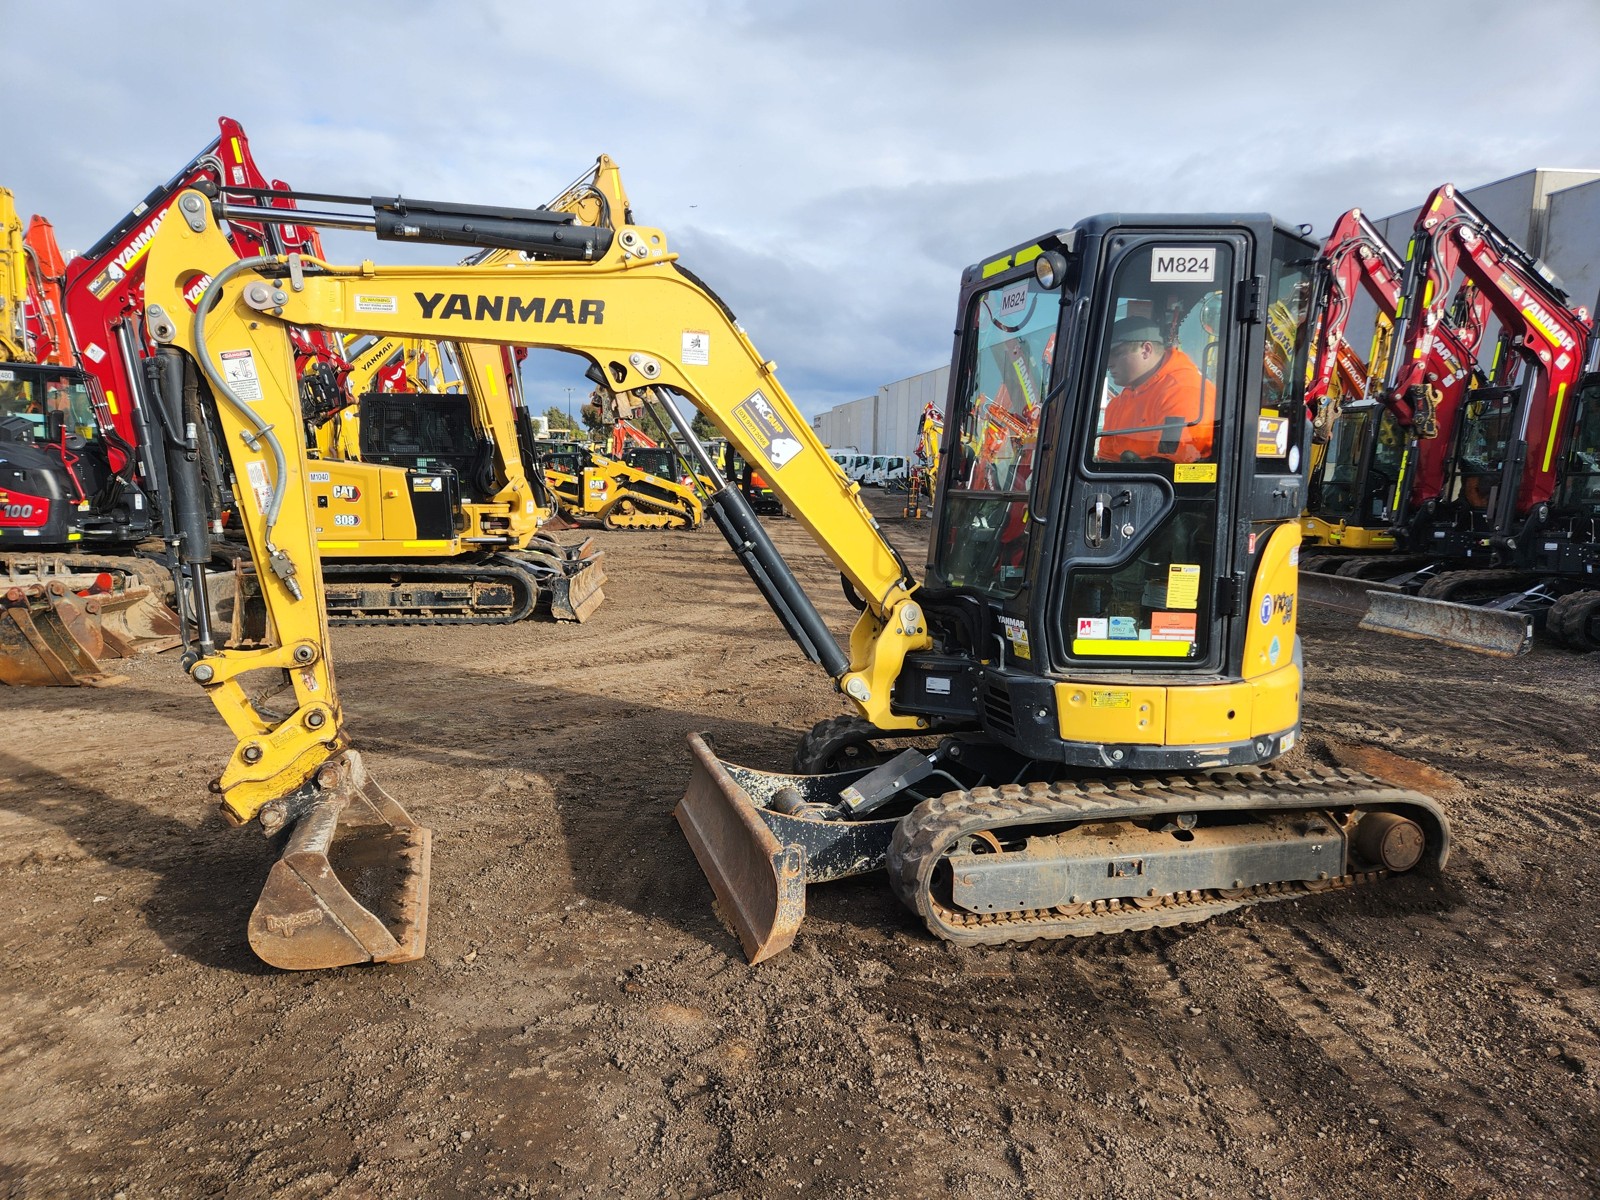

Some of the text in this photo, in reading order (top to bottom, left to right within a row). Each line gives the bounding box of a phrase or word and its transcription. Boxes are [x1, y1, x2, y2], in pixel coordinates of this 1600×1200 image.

[1157, 257, 1209, 273] M824
[1002, 290, 1025, 309] M824
[413, 292, 605, 325] YANMAR
[1521, 293, 1576, 352] YANMAR
[361, 341, 394, 371] YANMAR
[1341, 356, 1366, 391] HITACHI
[750, 392, 784, 434] PROQUIP
[746, 420, 757, 434] 9971
[310, 473, 329, 481] M1040
[590, 480, 605, 490] CAT
[333, 485, 355, 499] CAT
[335, 515, 355, 525] 308
[997, 614, 1025, 629] YANMAR
